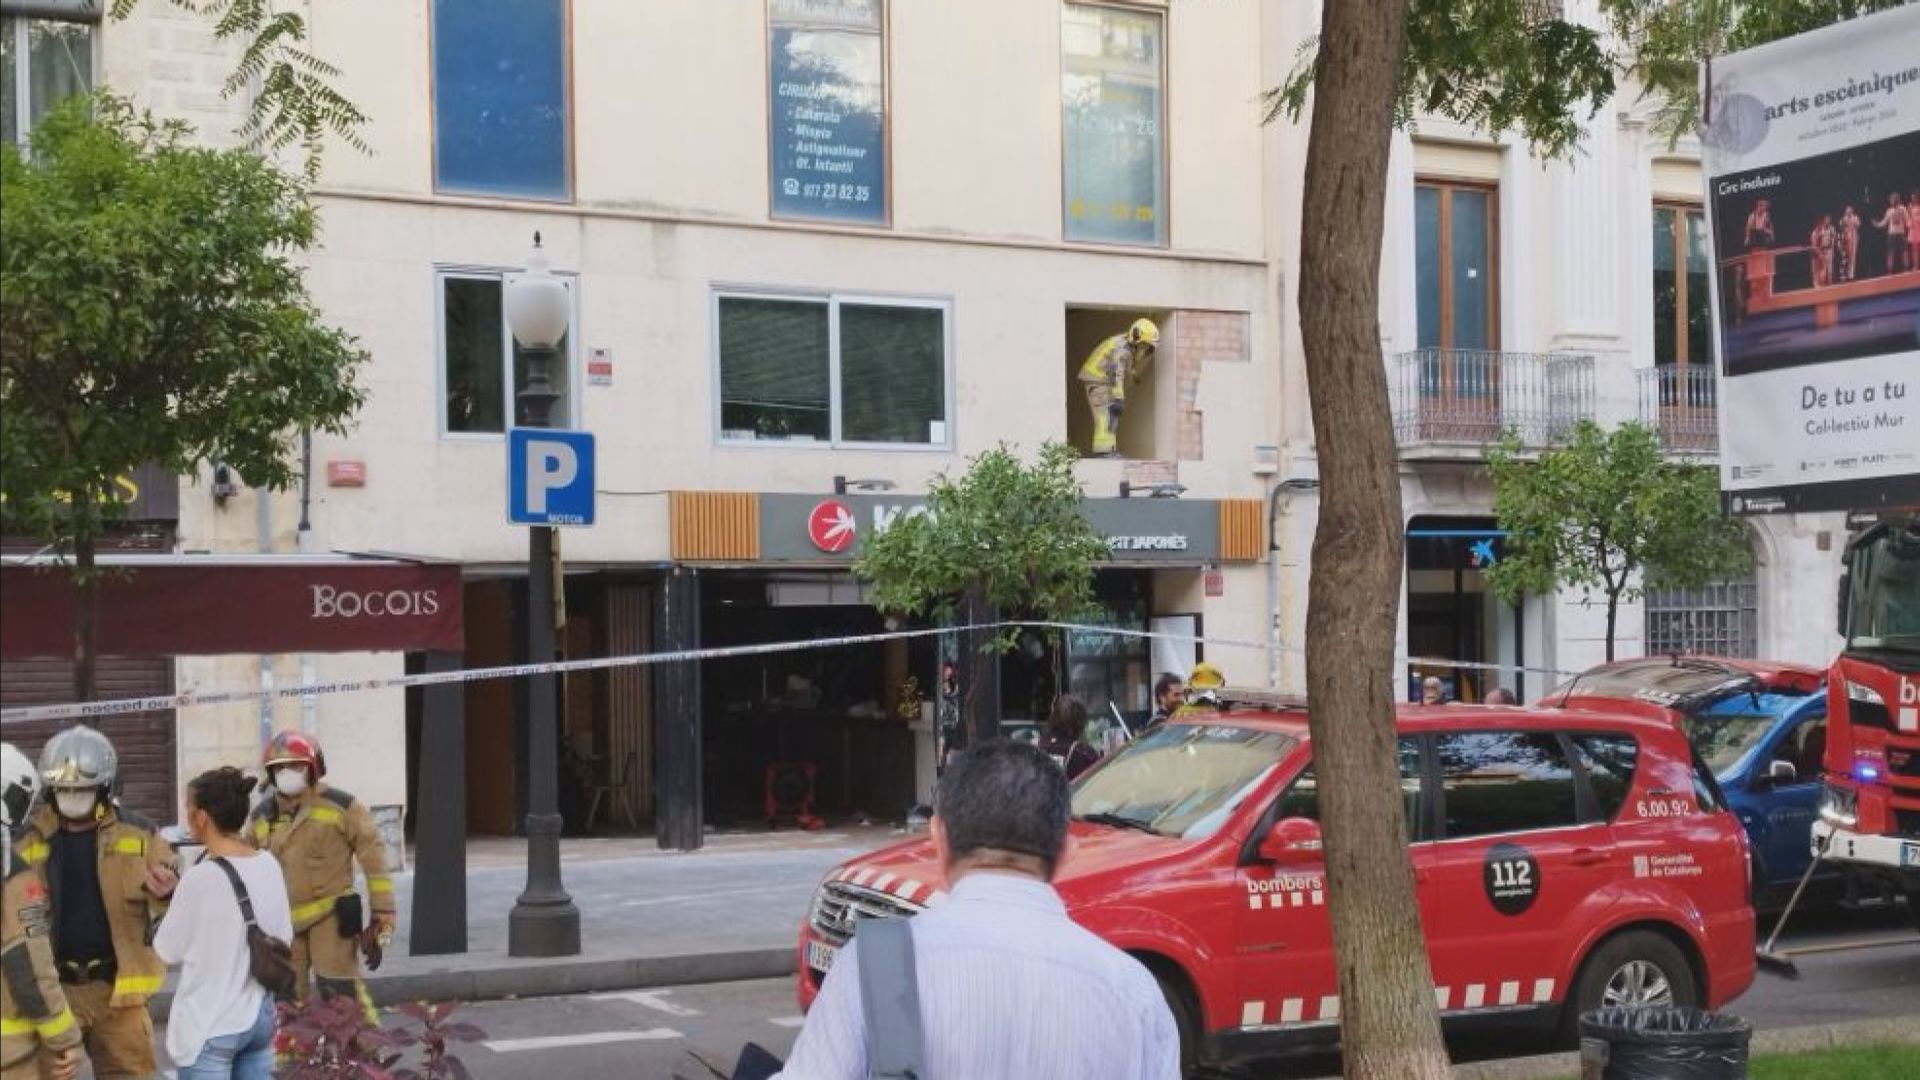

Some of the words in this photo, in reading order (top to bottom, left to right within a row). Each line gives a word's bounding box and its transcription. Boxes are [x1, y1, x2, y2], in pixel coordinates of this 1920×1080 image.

[1764, 96, 1809, 121] arts
[1814, 65, 1920, 106] escènique
[803, 183, 821, 198] 977
[823, 182, 837, 199] 23
[838, 184, 854, 200] 82
[855, 185, 871, 202] 35
[1718, 181, 1739, 196] Circ
[1802, 385, 1828, 410] De
[1835, 386, 1855, 406] tu
[1862, 387, 1875, 403] a
[1884, 381, 1906, 400] tu
[1874, 412, 1905, 429] Mur
[526, 440, 578, 514] P
[309, 584, 439, 618] BOCOIS
[1247, 872, 1323, 894] bombers
[1491, 860, 1532, 887] 112
